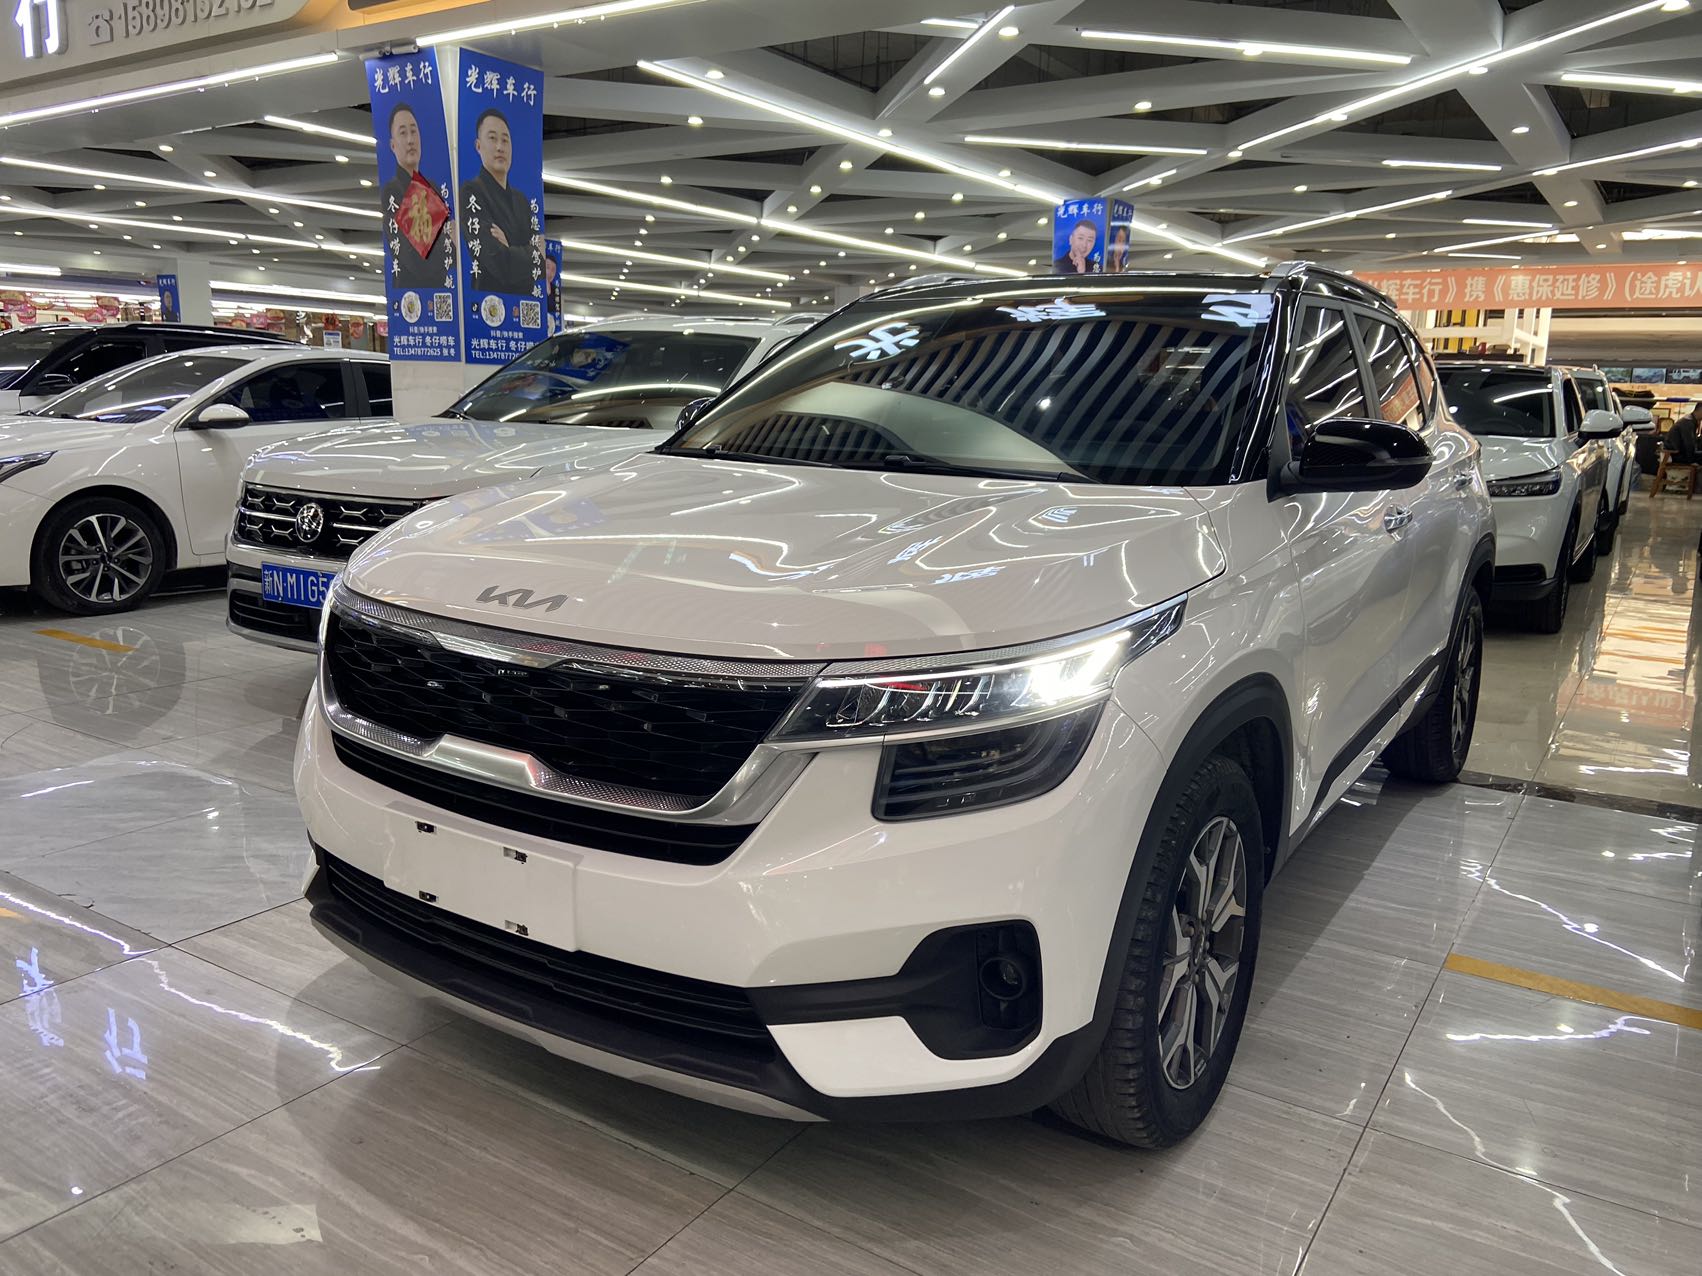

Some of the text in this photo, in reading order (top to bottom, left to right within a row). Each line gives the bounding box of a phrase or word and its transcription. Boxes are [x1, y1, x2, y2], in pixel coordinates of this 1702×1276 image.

[374, 60, 433, 94] 光辉车行
[465, 64, 538, 107] 光辉车行
[1057, 203, 1104, 218] 光辉车行
[386, 194, 401, 278] 冬仔唠车
[440, 182, 456, 289] 为保驾护航
[466, 193, 483, 280] 冬仔唠车
[529, 198, 544, 298] 为您保驾护航
[393, 335, 423, 346] 光辉车行
[471, 337, 538, 352] 光辉车行 冬仔唠
[475, 585, 569, 613] KIA
